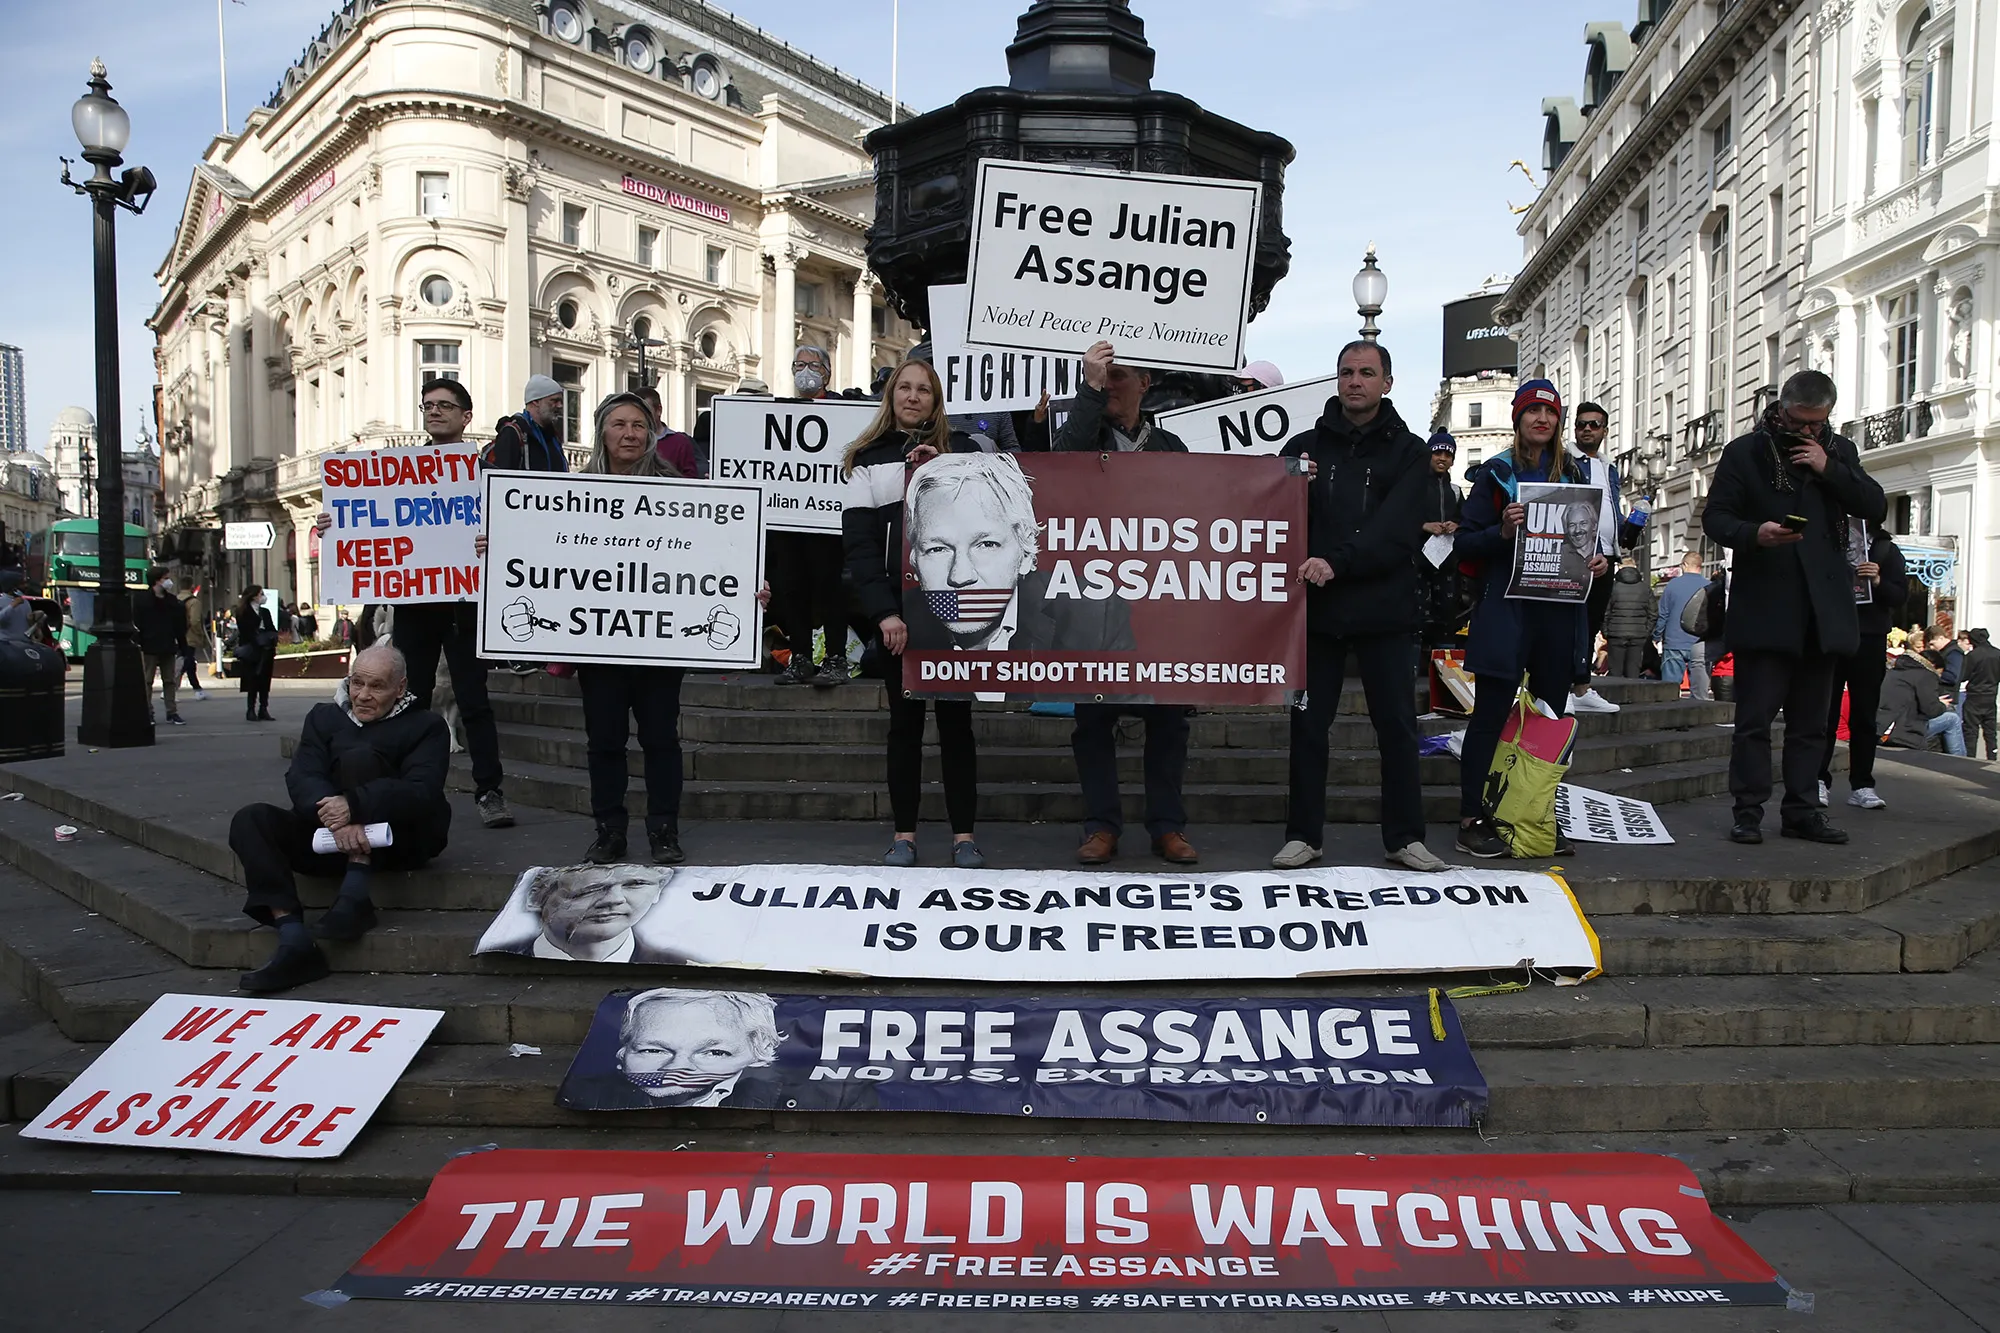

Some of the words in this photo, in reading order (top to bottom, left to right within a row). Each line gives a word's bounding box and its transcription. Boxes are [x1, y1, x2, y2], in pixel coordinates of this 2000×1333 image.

[623, 176, 667, 205] BODY
[669, 191, 730, 222] WORLDS
[994, 191, 1092, 237] Free
[1109, 202, 1236, 250] Julian
[1014, 244, 1207, 304] Assange
[981, 305, 1034, 328] Nobel
[1039, 311, 1091, 334] Peace
[1096, 316, 1144, 339] Prize
[1148, 322, 1229, 347] Nominee
[1490, 325, 1509, 336] GOO
[764, 413, 829, 453] NO
[1218, 404, 1289, 451] NO
[332, 498, 389, 528] TFL
[504, 488, 624, 519] Crushing
[634, 494, 745, 525] Assange
[766, 493, 799, 509] ulian
[805, 496, 843, 512] Assa
[1527, 502, 1566, 534] UK
[336, 536, 413, 567] KEEP
[555, 532, 567, 544] is
[574, 532, 598, 546] the
[603, 534, 640, 547] start
[646, 536, 664, 551] of
[667, 537, 692, 550] the
[1048, 517, 1199, 552] HANDS
[1209, 518, 1289, 554] OFF
[1525, 537, 1563, 553] DON'T
[78, 569, 100, 579] Victo
[1522, 562, 1560, 572] ASSANGE
[1524, 553, 1561, 562] EXTRADITE
[505, 558, 738, 597] Surveillance
[1044, 559, 1288, 603] ASSANGE
[568, 606, 673, 639] STATE
[920, 660, 991, 681] DON'T
[996, 661, 1084, 682] SHOOT
[1085, 662, 1130, 682] THE
[1135, 663, 1286, 684] MESSENGER
[1582, 796, 1619, 841] AGAINST
[1616, 798, 1656, 838] AUSSIES
[693, 883, 901, 910] JULIAN
[917, 884, 1243, 912] ASSANGE'S
[1264, 884, 1530, 911] FREEDOM
[863, 922, 917, 950] IS
[939, 924, 1065, 952] OUR
[1086, 920, 1369, 952] FREEDOM
[162, 1006, 268, 1044] WE
[269, 1013, 400, 1053] ARE
[819, 1009, 1016, 1062] FREE
[1041, 1009, 1420, 1063] ASSANGE
[174, 1050, 298, 1092] ALL
[808, 1066, 895, 1081] NO
[909, 1067, 1020, 1083] U.S.
[1035, 1066, 1434, 1085] EXTRADITION
[44, 1089, 355, 1147] ASSANGE
[456, 1193, 644, 1250] THE
[684, 1182, 1023, 1246] WORLD
[1065, 1182, 1149, 1244] IS
[1190, 1184, 1693, 1256] WATCHING
[626, 1288, 877, 1307] #TRANSPARENCY
[1628, 1288, 1731, 1304] #HOPE
